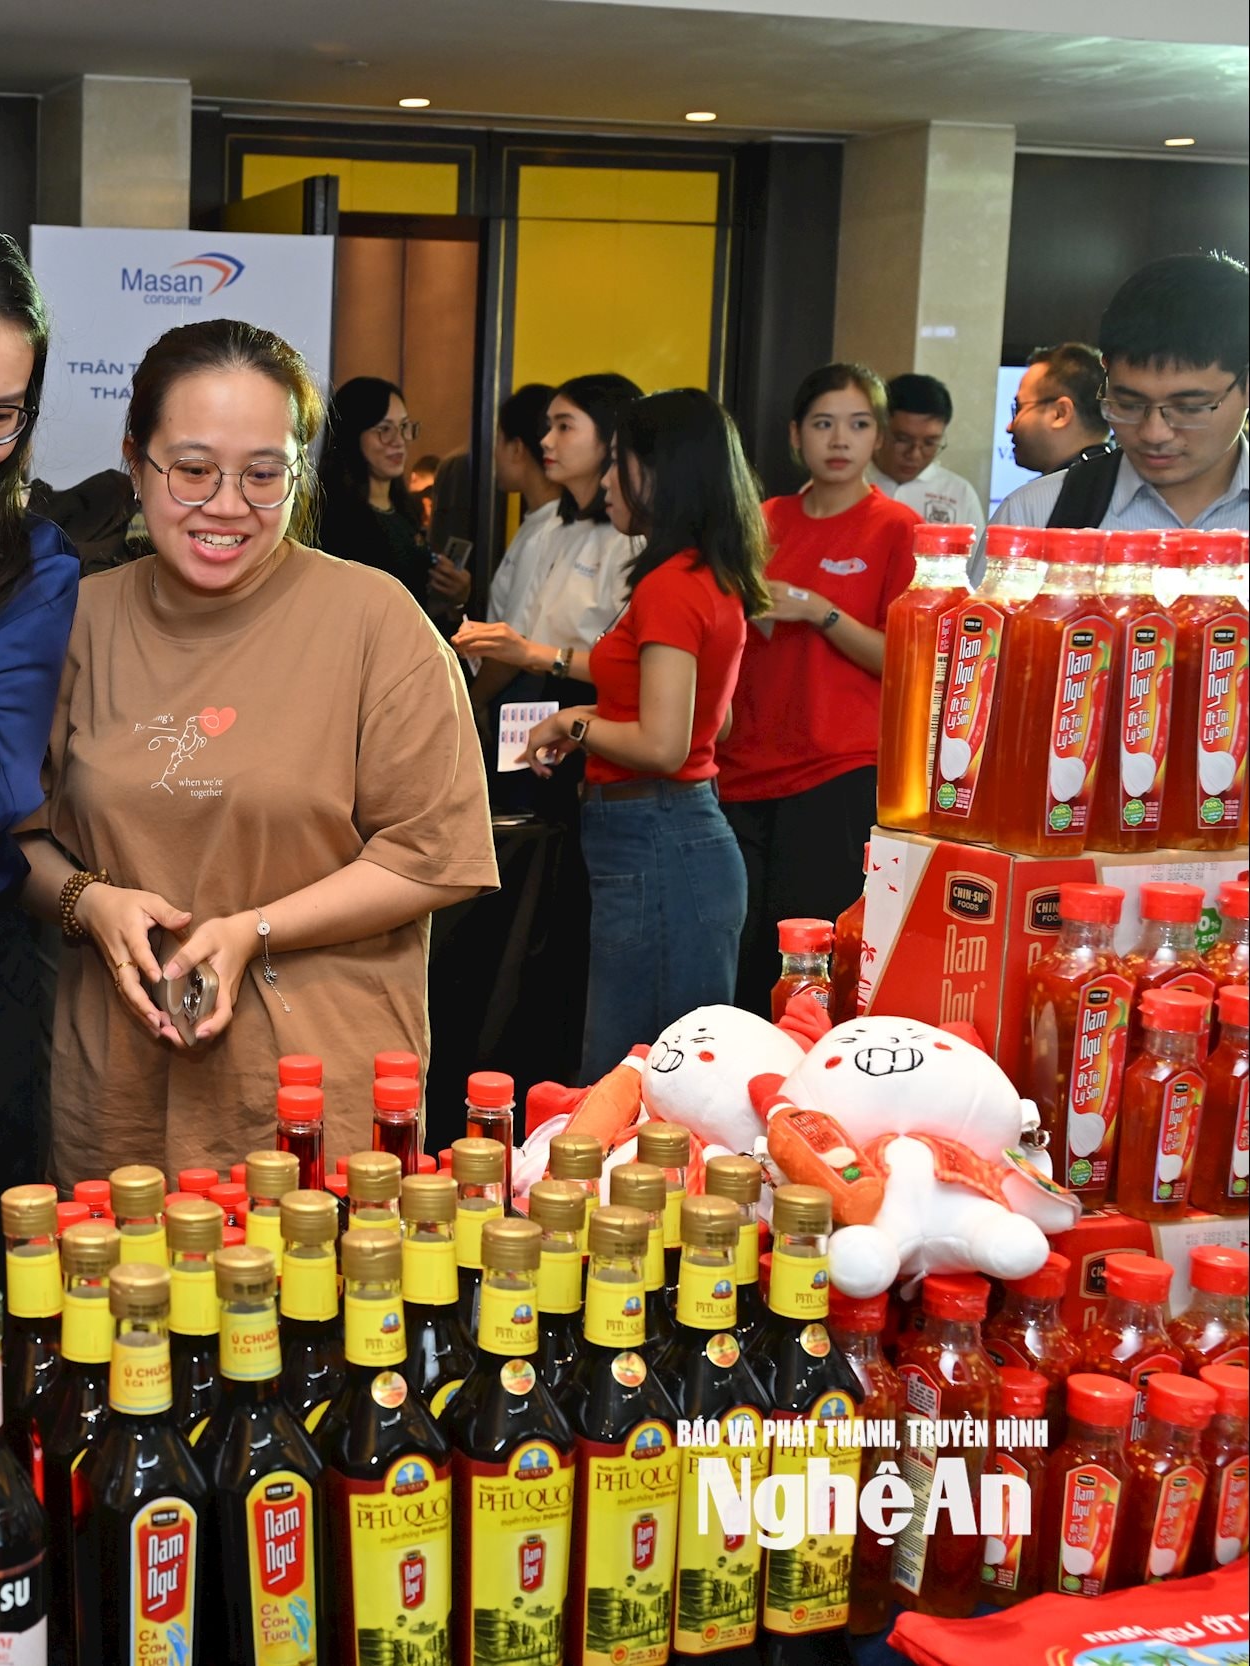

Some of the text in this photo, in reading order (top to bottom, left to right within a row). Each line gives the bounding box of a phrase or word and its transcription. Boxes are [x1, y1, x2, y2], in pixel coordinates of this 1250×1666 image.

[121, 267, 203, 293] Masan
[144, 294, 203, 306] consumer
[67, 359, 124, 375] TRÂN
[90, 386, 131, 399] THA
[958, 636, 981, 660] Nam
[1131, 648, 1155, 673] Nam
[1209, 647, 1234, 673] Nam
[1066, 651, 1092, 677] Nam
[953, 661, 975, 694] Ngư
[1207, 673, 1230, 708] Ngư
[1062, 677, 1086, 713] Ngư
[1129, 673, 1150, 709] Ngư
[178, 778, 222, 787] when we're
[190, 789, 222, 799] together
[957, 900, 979, 911] FOODS
[1036, 902, 1060, 914] CHIN
[943, 924, 988, 975] Nam
[1082, 1009, 1107, 1033] Nam
[1080, 1033, 1101, 1070] Ngư
[264, 1506, 299, 1541] Nam
[148, 1533, 184, 1568] Nam
[266, 1536, 297, 1585] Ngư
[147, 1563, 179, 1612] Ngư
